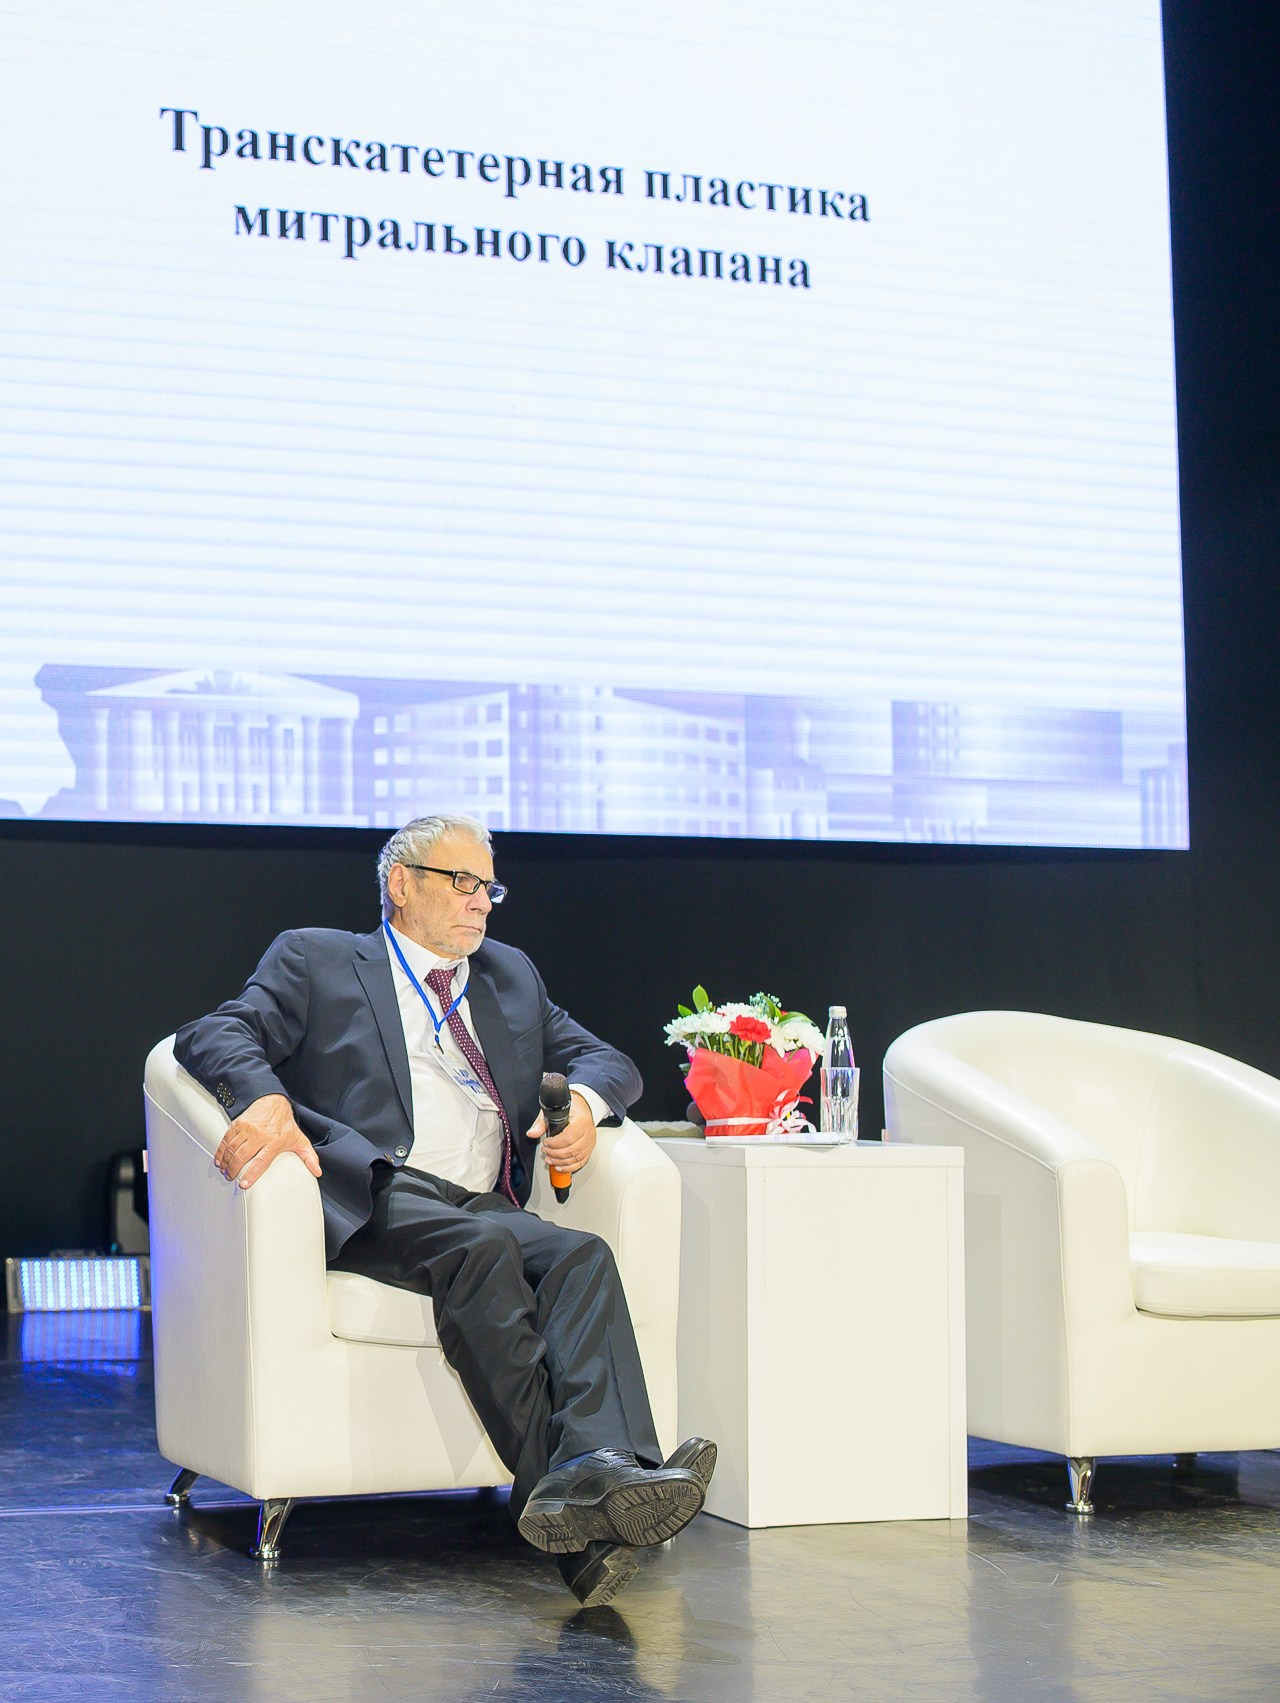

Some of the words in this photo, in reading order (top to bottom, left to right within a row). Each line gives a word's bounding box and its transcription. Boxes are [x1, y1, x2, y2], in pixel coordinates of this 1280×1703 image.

[158, 106, 624, 199] Транскатетерная
[644, 170, 870, 222] пластика
[233, 204, 587, 267] митрального
[605, 239, 812, 289] клапана
